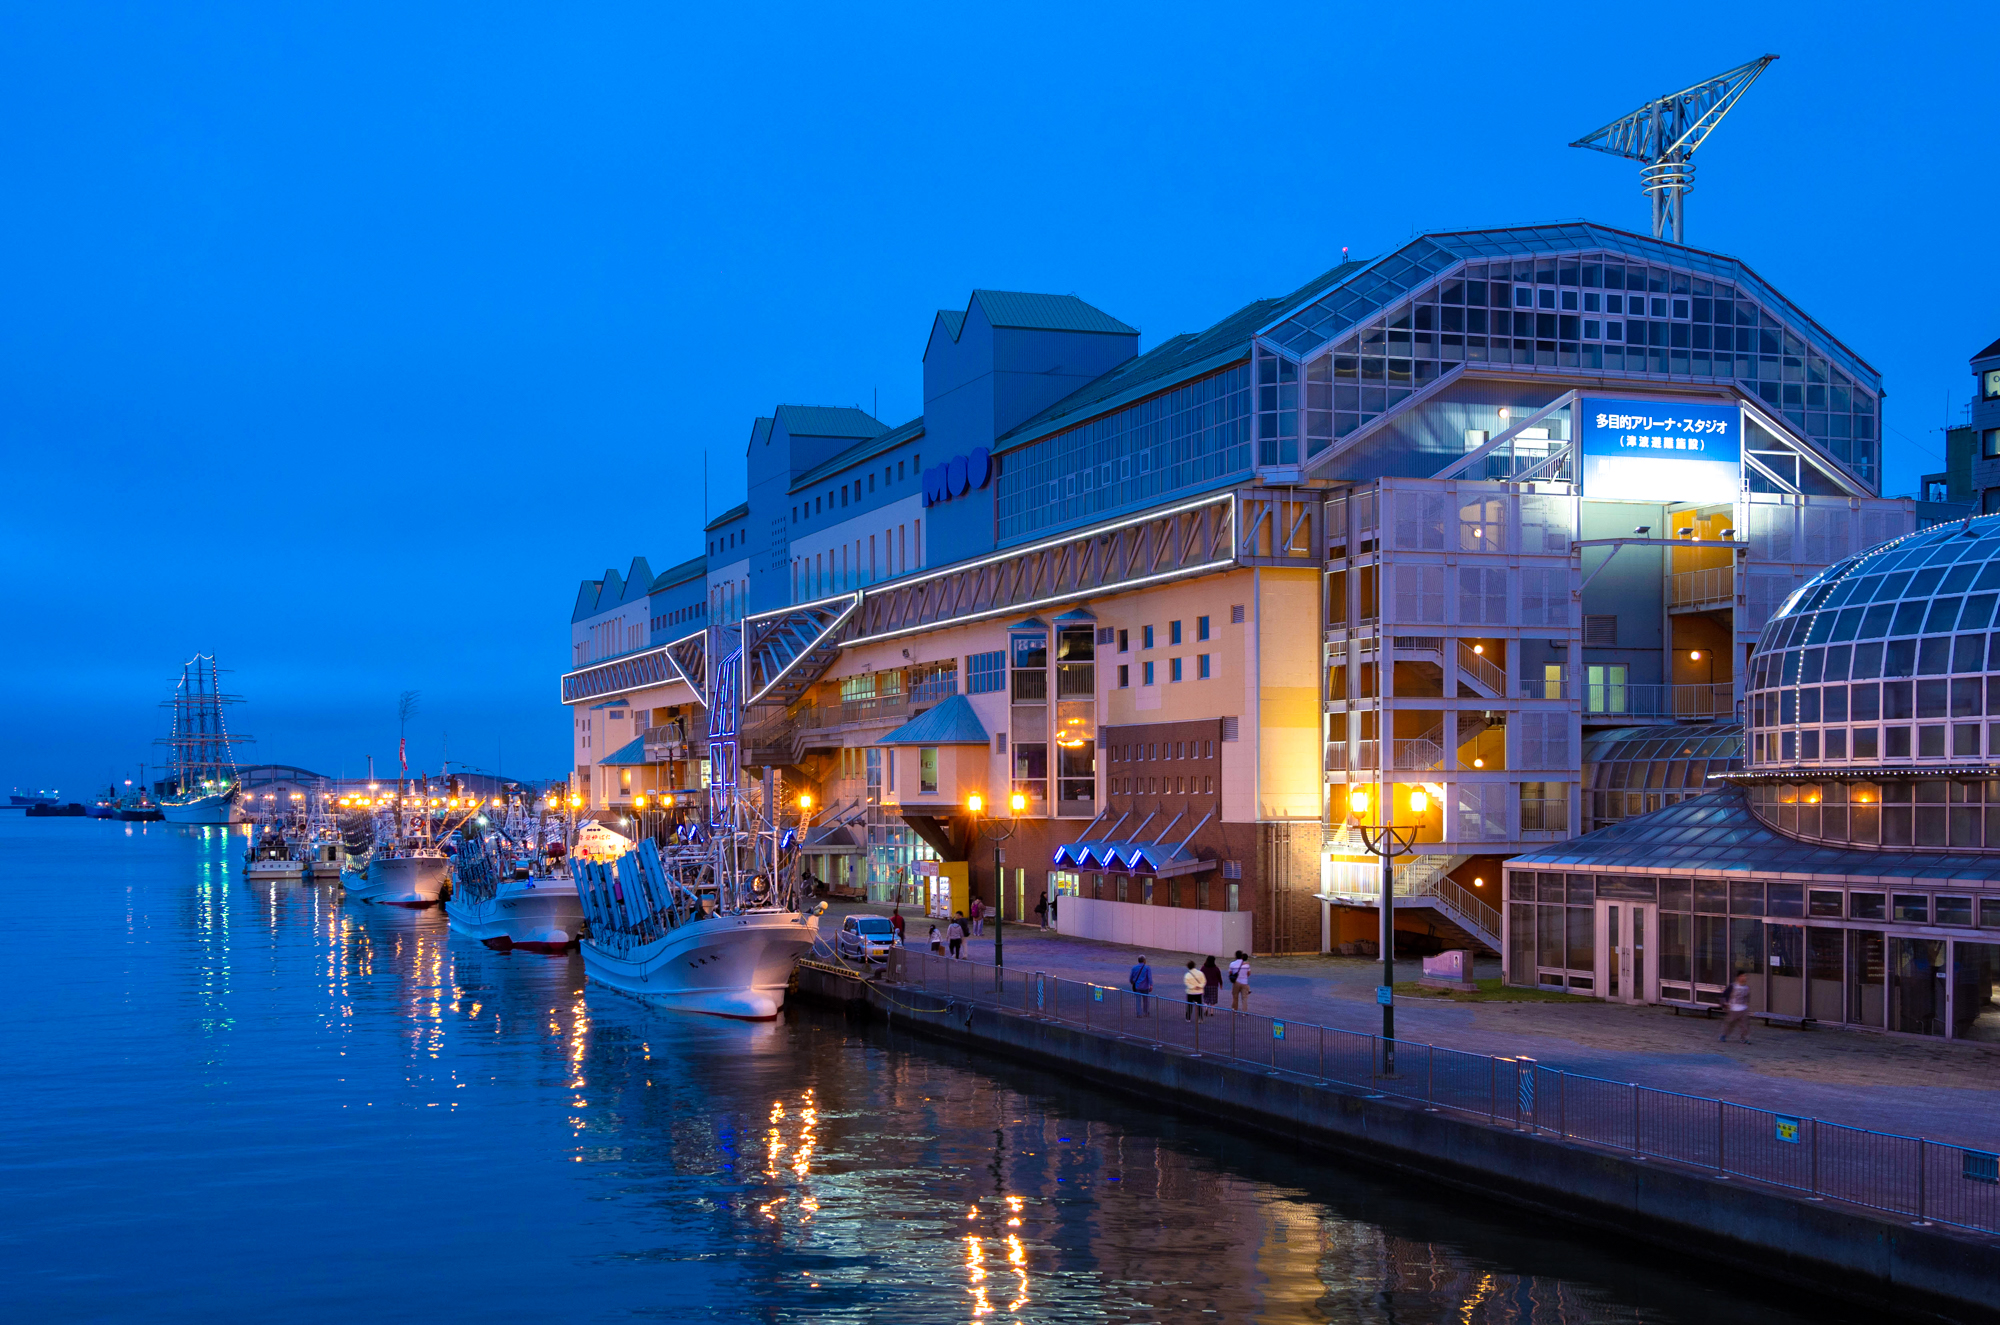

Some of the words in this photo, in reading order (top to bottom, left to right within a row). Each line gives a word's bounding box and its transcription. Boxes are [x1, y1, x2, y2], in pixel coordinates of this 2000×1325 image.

[1596, 413, 1728, 435] 多目的アリーナ・スタジオ
[922, 446, 993, 508] MOO
